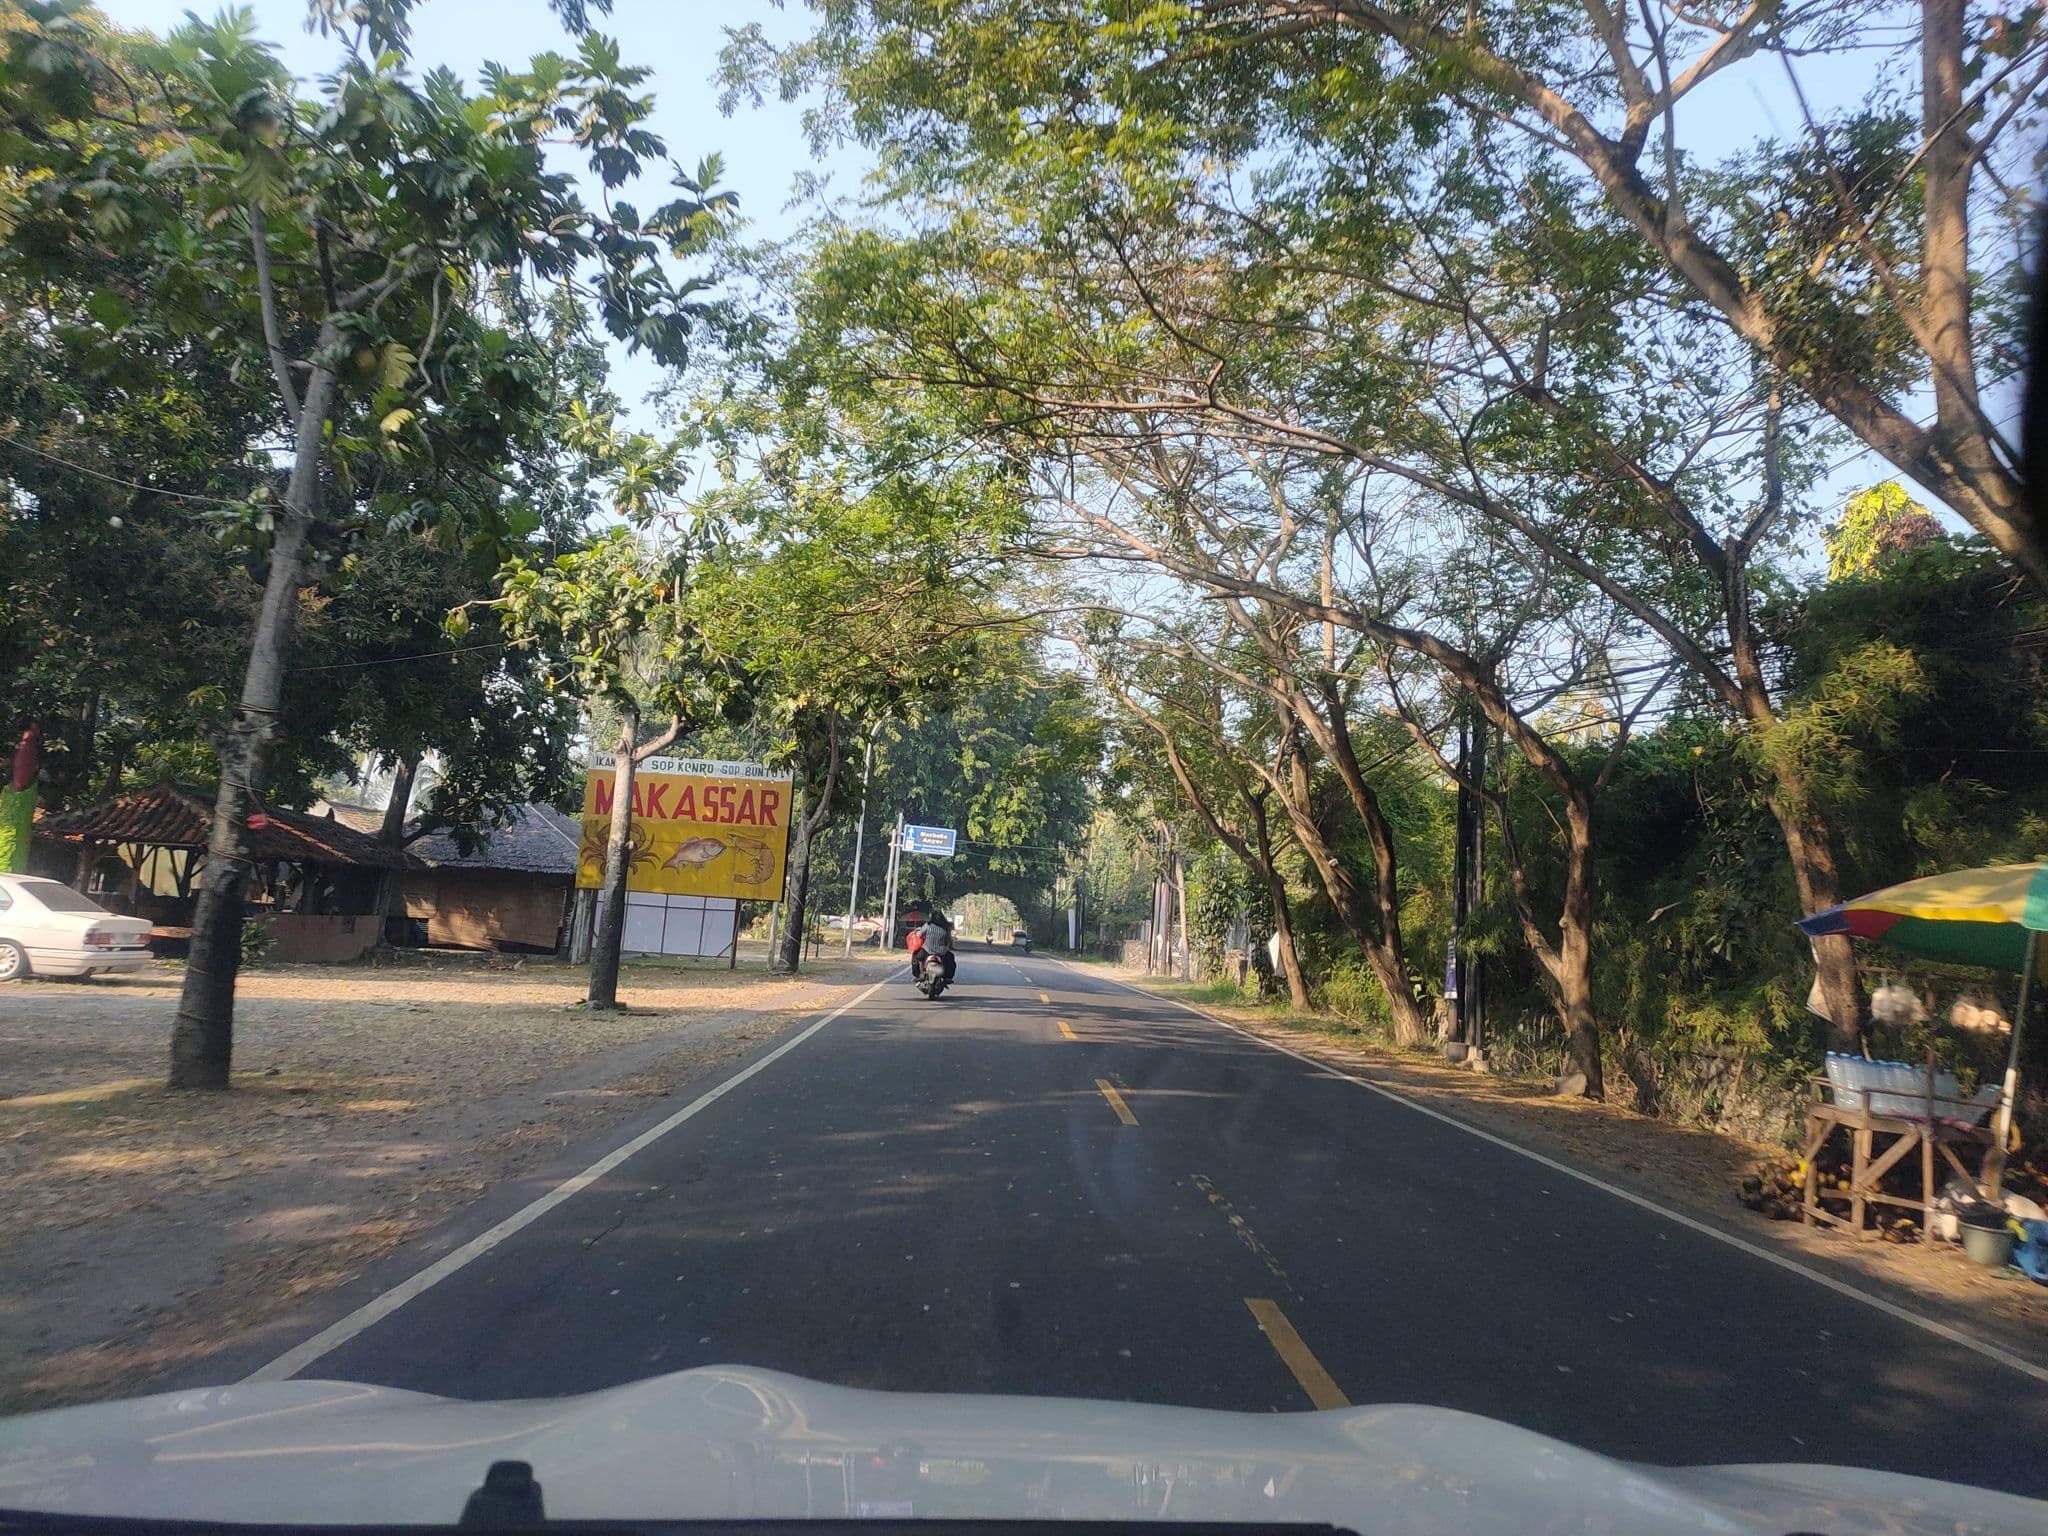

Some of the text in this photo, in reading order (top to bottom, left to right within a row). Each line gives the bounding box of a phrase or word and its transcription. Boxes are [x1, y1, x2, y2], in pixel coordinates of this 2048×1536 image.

[651, 760, 674, 771] SOP
[677, 761, 714, 773] KONRO
[720, 765, 740, 776] SOP
